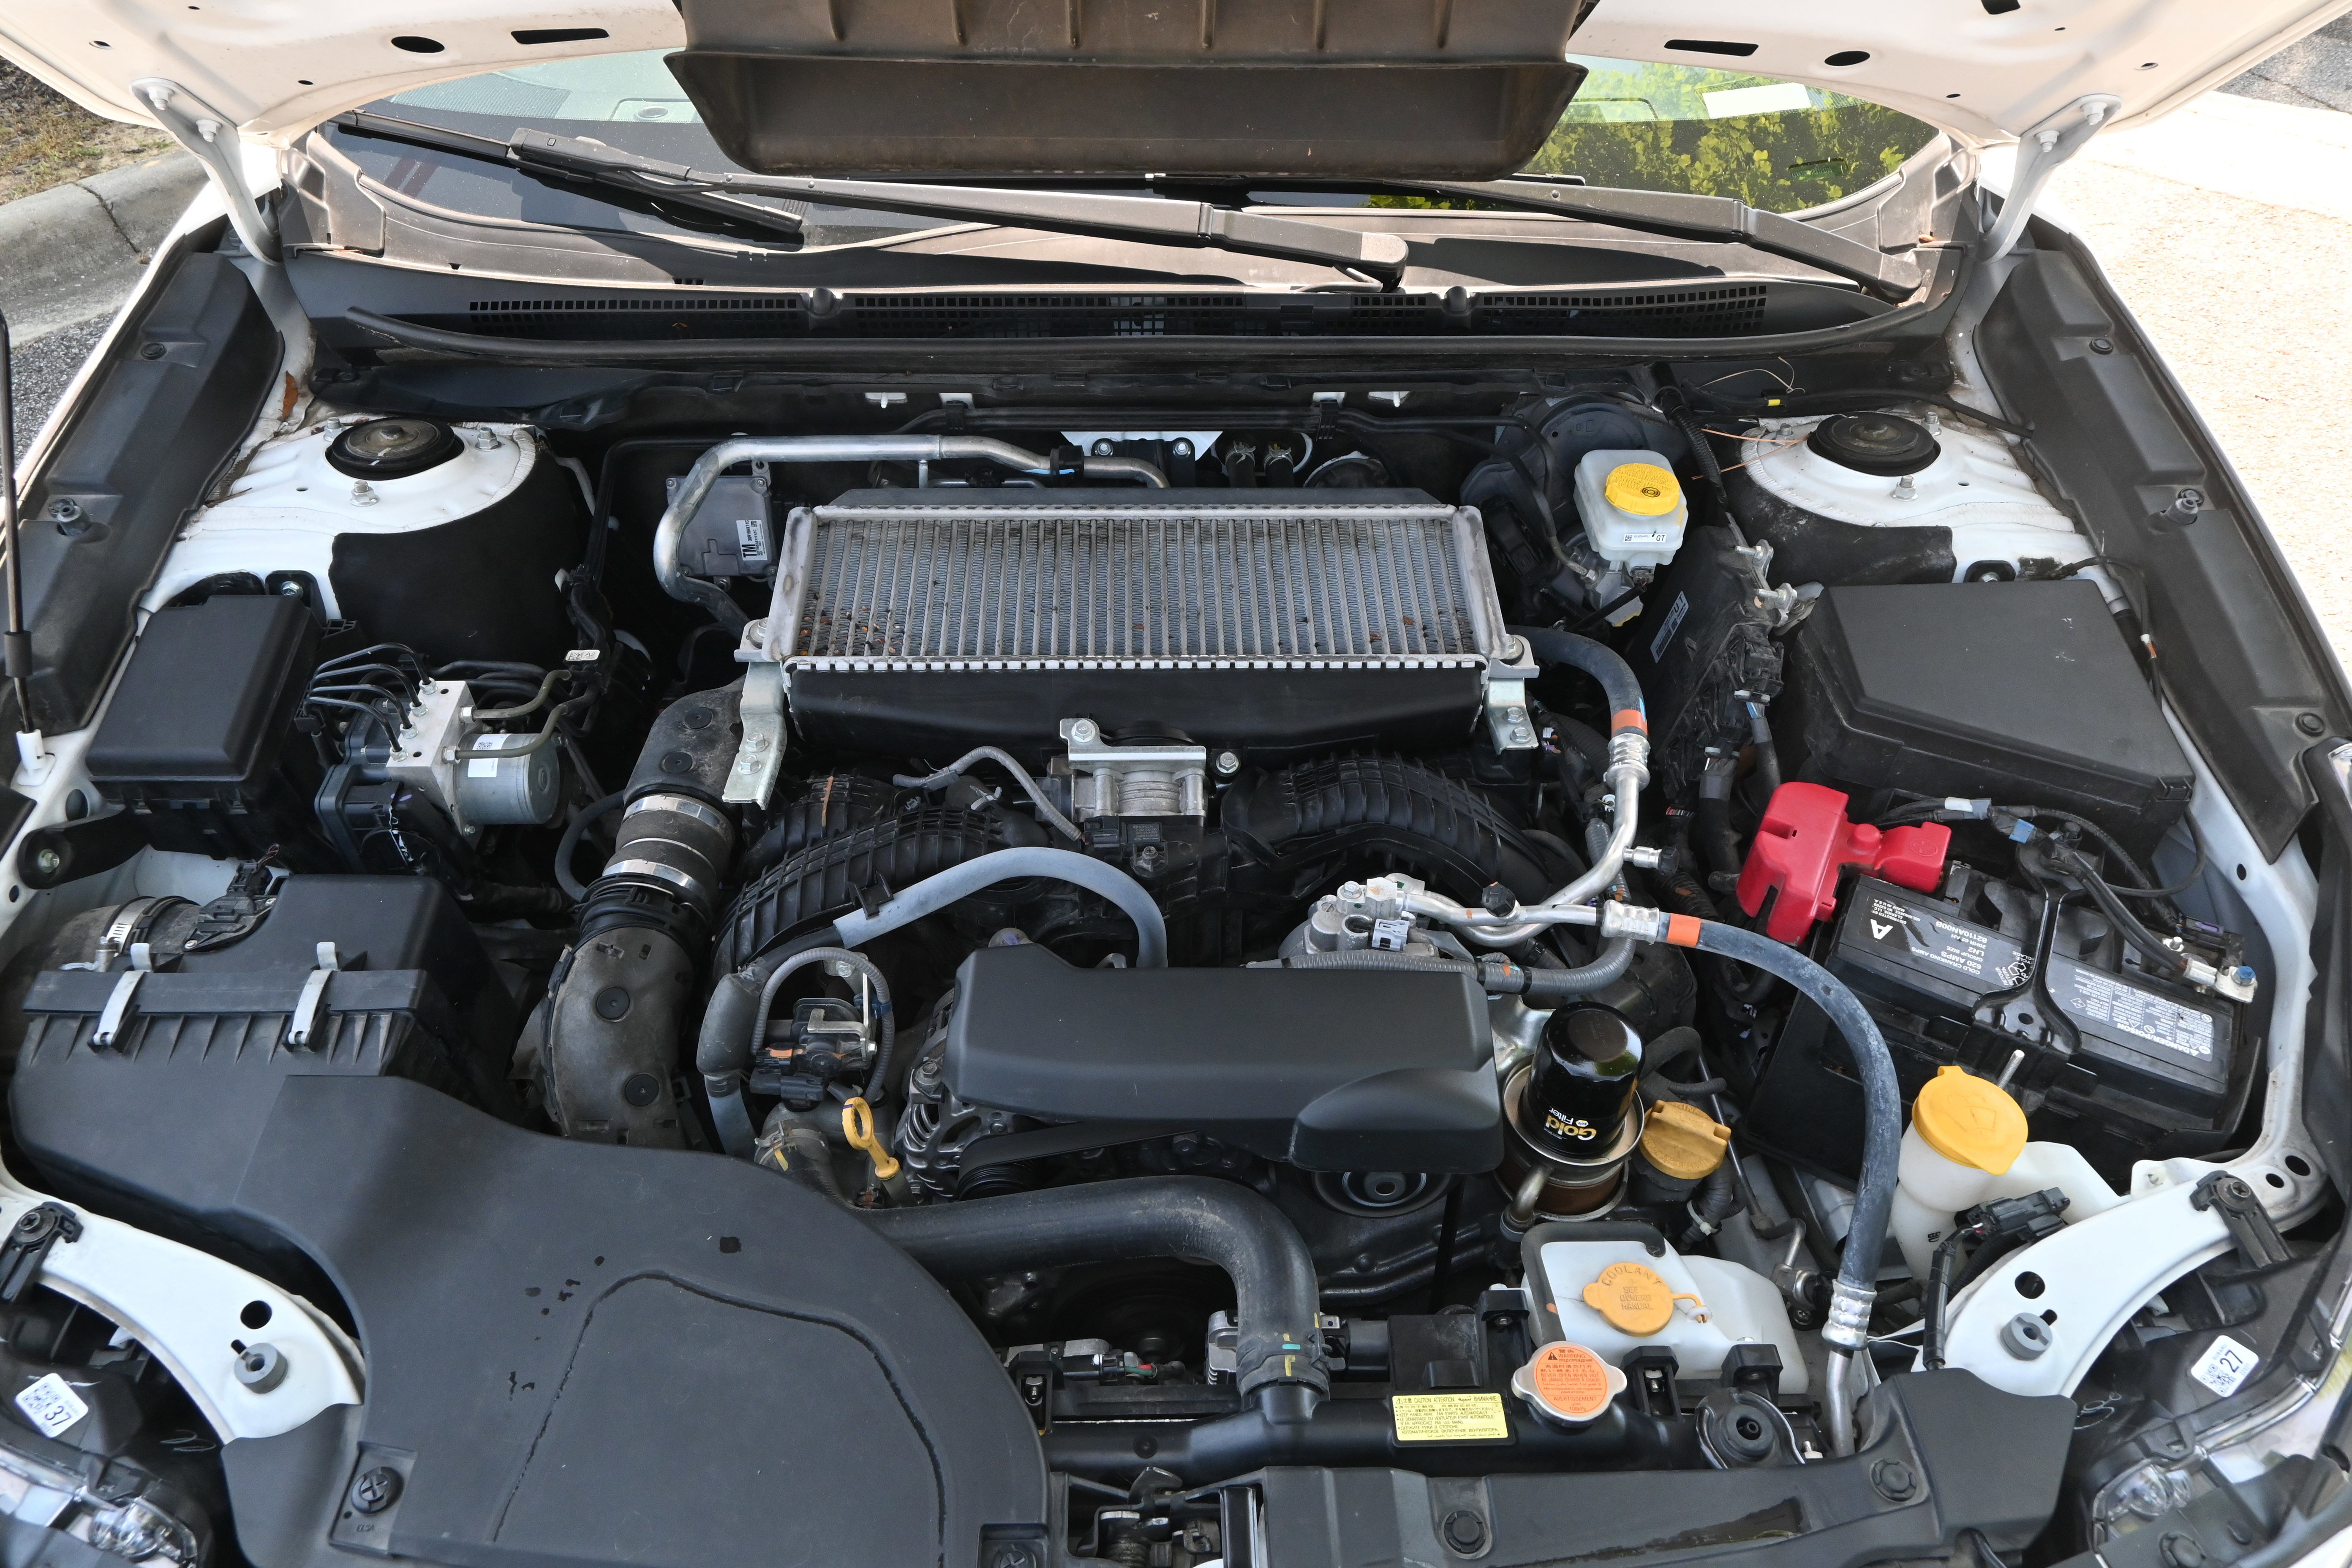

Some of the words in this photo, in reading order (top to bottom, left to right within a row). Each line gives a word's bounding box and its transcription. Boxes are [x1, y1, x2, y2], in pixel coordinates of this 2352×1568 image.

[741, 544, 757, 558] TM
[1878, 912, 1907, 924] DISTRIBUTED
[1935, 921, 1988, 942] 82110AN00B
[1946, 945, 1960, 954] SIZE
[1967, 946, 1985, 956] LN2
[1969, 940, 1986, 949] 20HR
[1911, 947, 1929, 956] AMPS
[1940, 951, 1966, 964] AMPS
[1960, 951, 1984, 962] GROUP
[1930, 953, 1963, 968] CRANKING
[1966, 960, 1982, 969] 620
[1963, 965, 1981, 975] COLD
[1549, 1107, 1574, 1125] Filter
[1545, 1114, 1596, 1141] Gold
[1602, 1265, 1666, 1286] COOLANT
[2220, 1349, 2243, 1373] 27
[45, 1405, 72, 1426] 37
